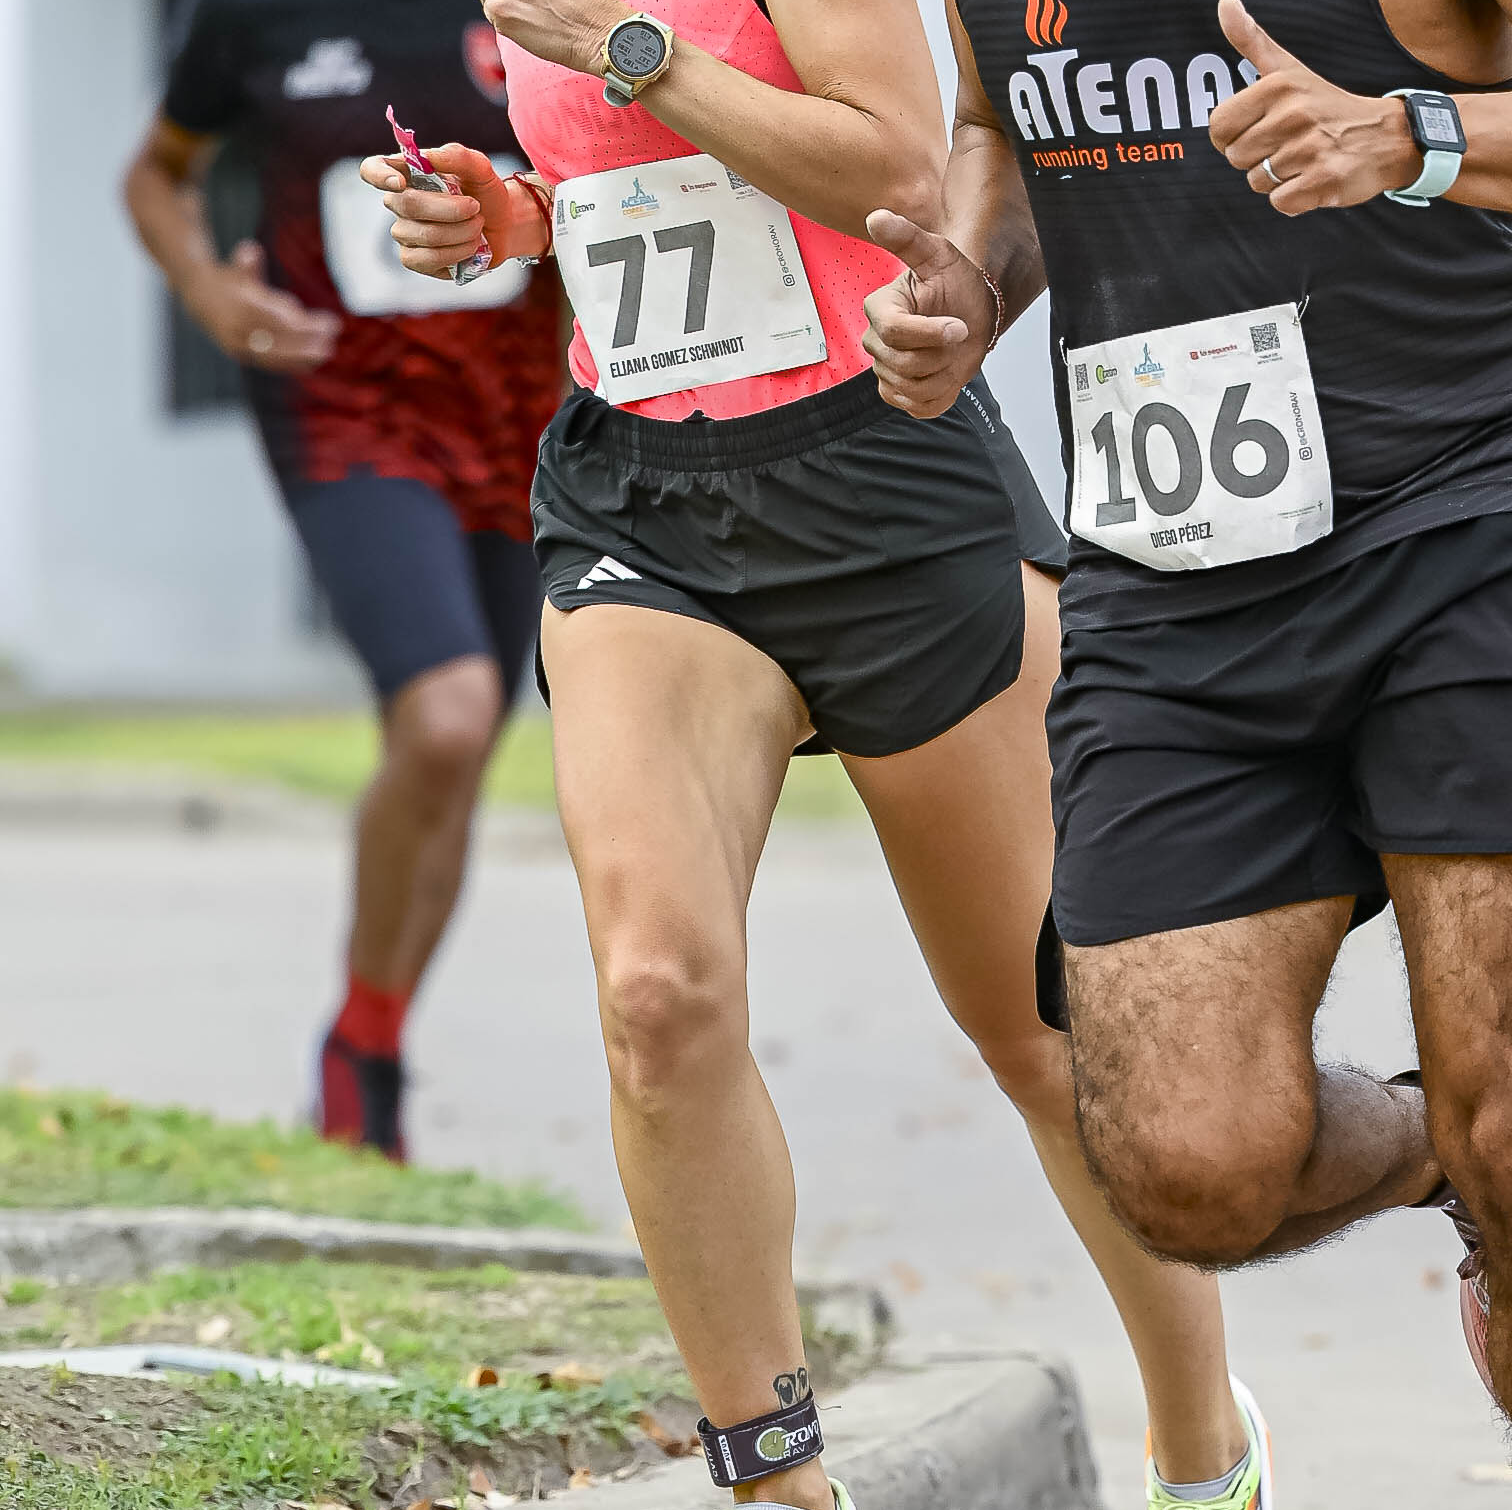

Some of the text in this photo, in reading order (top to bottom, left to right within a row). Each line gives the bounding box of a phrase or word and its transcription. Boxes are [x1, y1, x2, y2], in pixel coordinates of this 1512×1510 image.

[1009, 48, 1262, 141] ATENA
[1032, 142, 1184, 170] running team
[586, 220, 715, 349] 77
[610, 336, 745, 378] ELIANA GOMEZ SCHWINDT
[1091, 382, 1290, 527] 106
[1150, 521, 1213, 548] DIEGO PÉREZ
